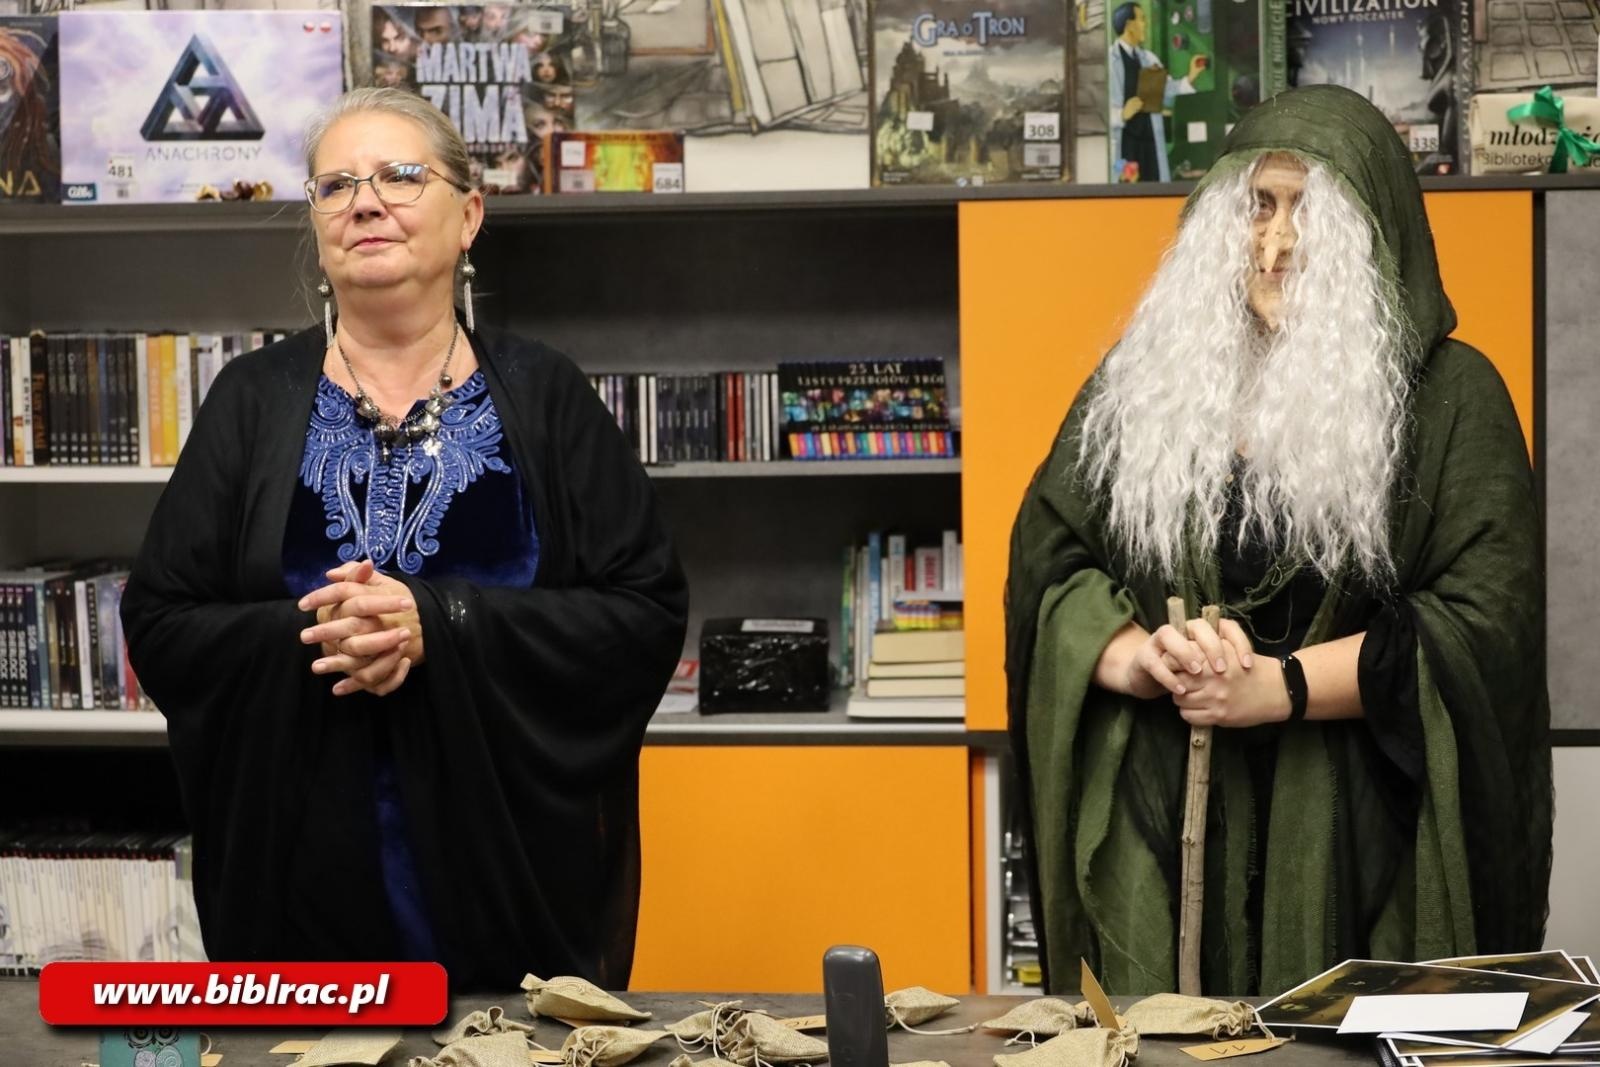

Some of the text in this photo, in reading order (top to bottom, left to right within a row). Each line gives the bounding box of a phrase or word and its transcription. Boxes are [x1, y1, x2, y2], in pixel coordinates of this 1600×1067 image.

[416, 42, 533, 83] MARTWA
[1028, 124, 1055, 137] 308
[146, 146, 262, 161] ANACHRONY
[108, 165, 133, 177] 481
[655, 177, 680, 190] 684
[873, 362, 902, 374] LAT
